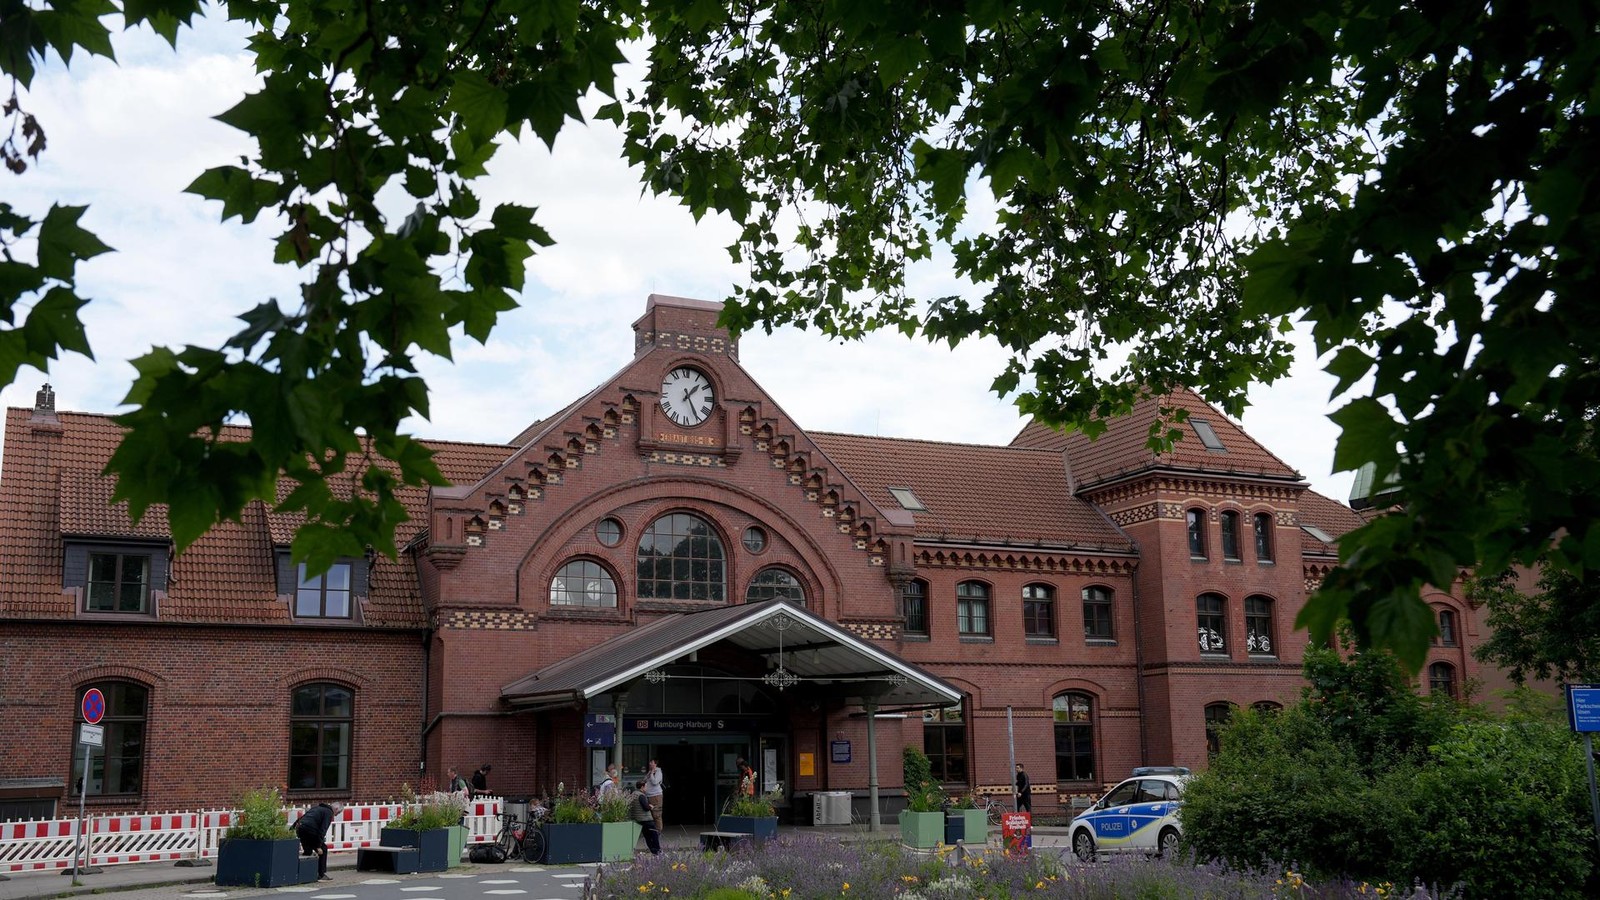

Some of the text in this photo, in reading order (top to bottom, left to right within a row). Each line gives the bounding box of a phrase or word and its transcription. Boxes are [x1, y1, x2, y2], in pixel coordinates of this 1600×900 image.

[637, 720, 724, 729] DB Hamburg-Harburg S
[1101, 822, 1123, 831] POLIZEI
